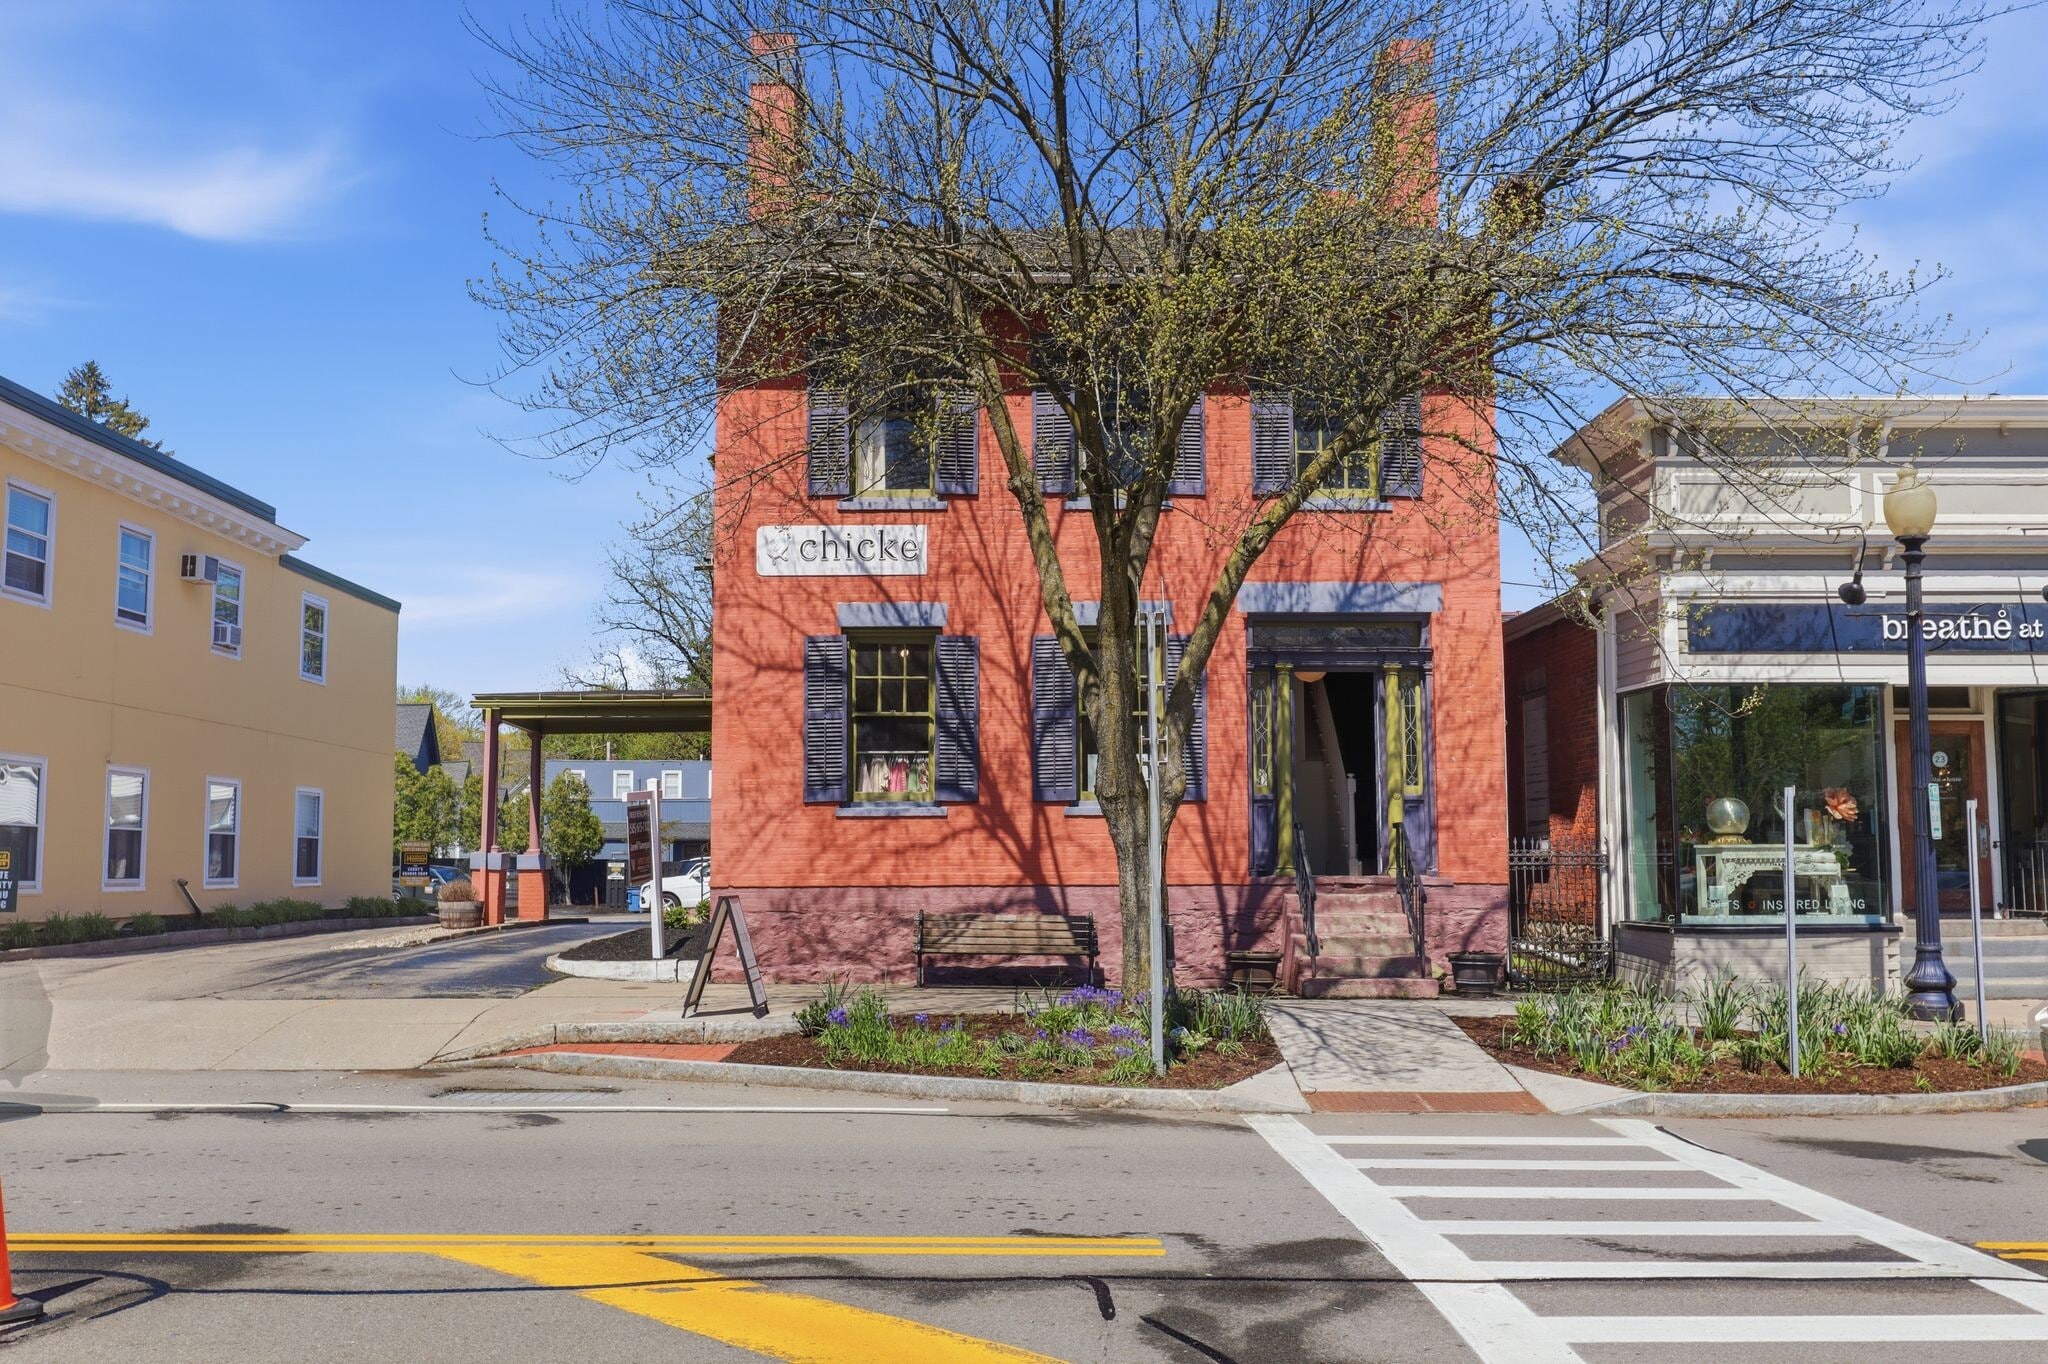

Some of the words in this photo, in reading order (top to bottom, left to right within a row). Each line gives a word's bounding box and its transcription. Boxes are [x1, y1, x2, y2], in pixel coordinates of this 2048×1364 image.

[799, 530, 919, 562] chicke
[2018, 619, 2044, 638] at
[1934, 755, 1946, 764] 23
[1762, 899, 1820, 910] INSRED
[1825, 899, 1866, 910] LNG
